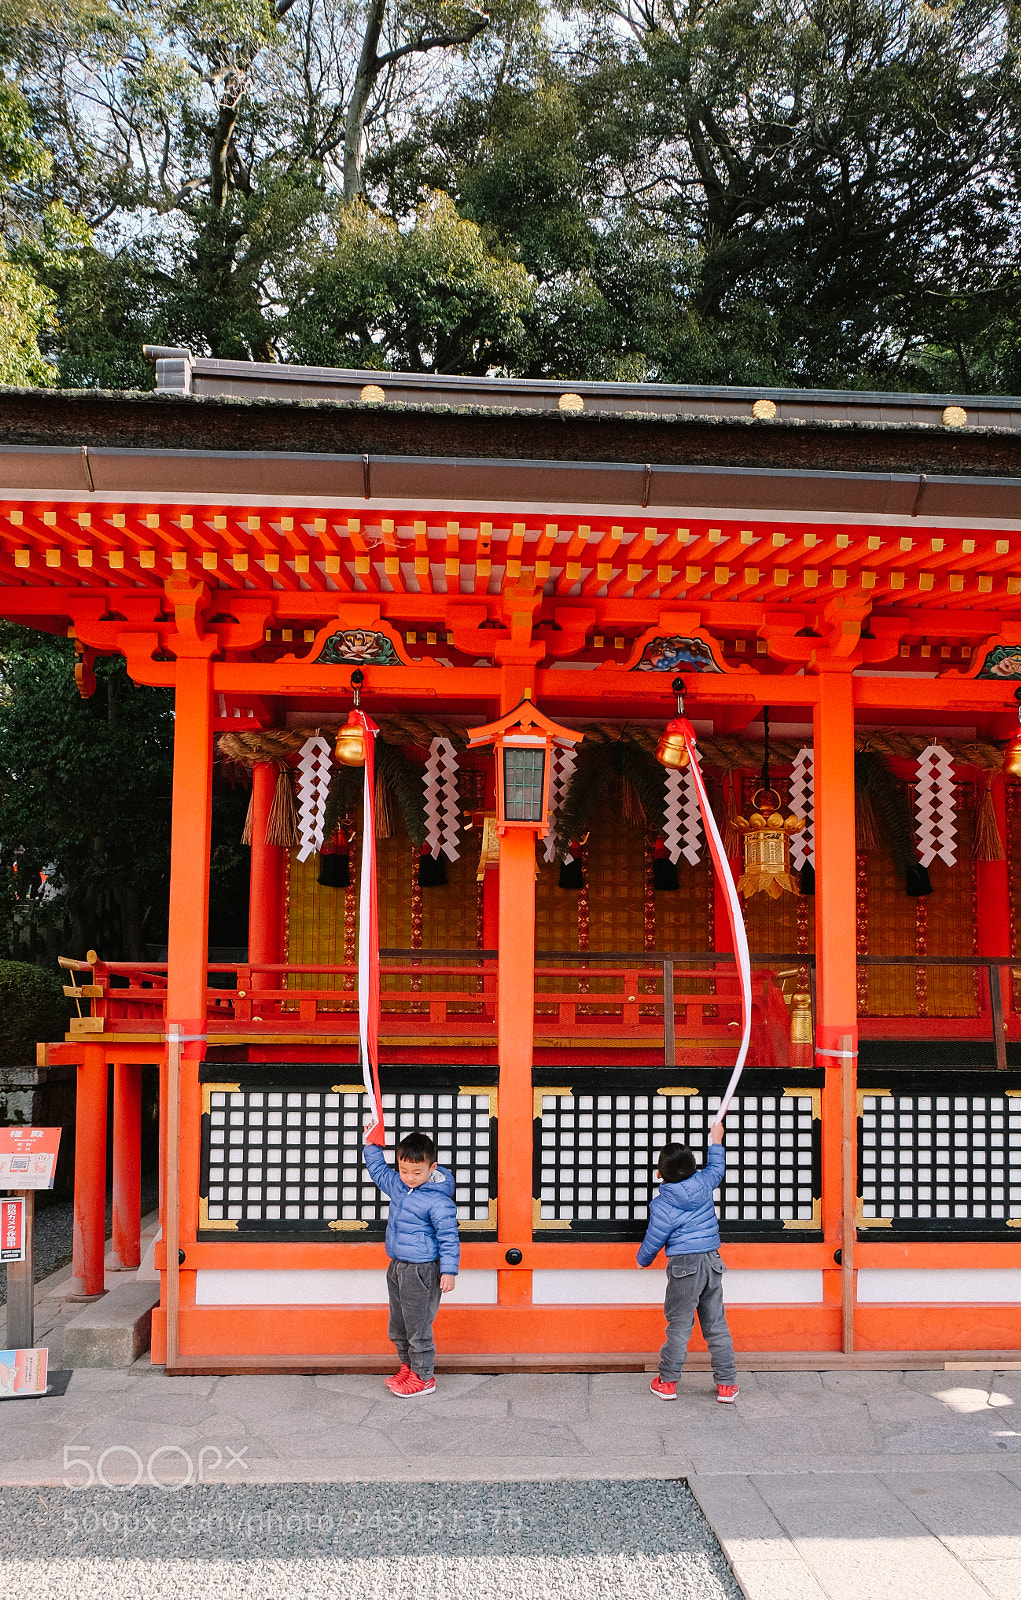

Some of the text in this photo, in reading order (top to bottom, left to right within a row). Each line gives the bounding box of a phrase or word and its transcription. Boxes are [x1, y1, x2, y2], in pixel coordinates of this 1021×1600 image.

[7, 1203, 17, 1247] 防犯カメラ作動中
